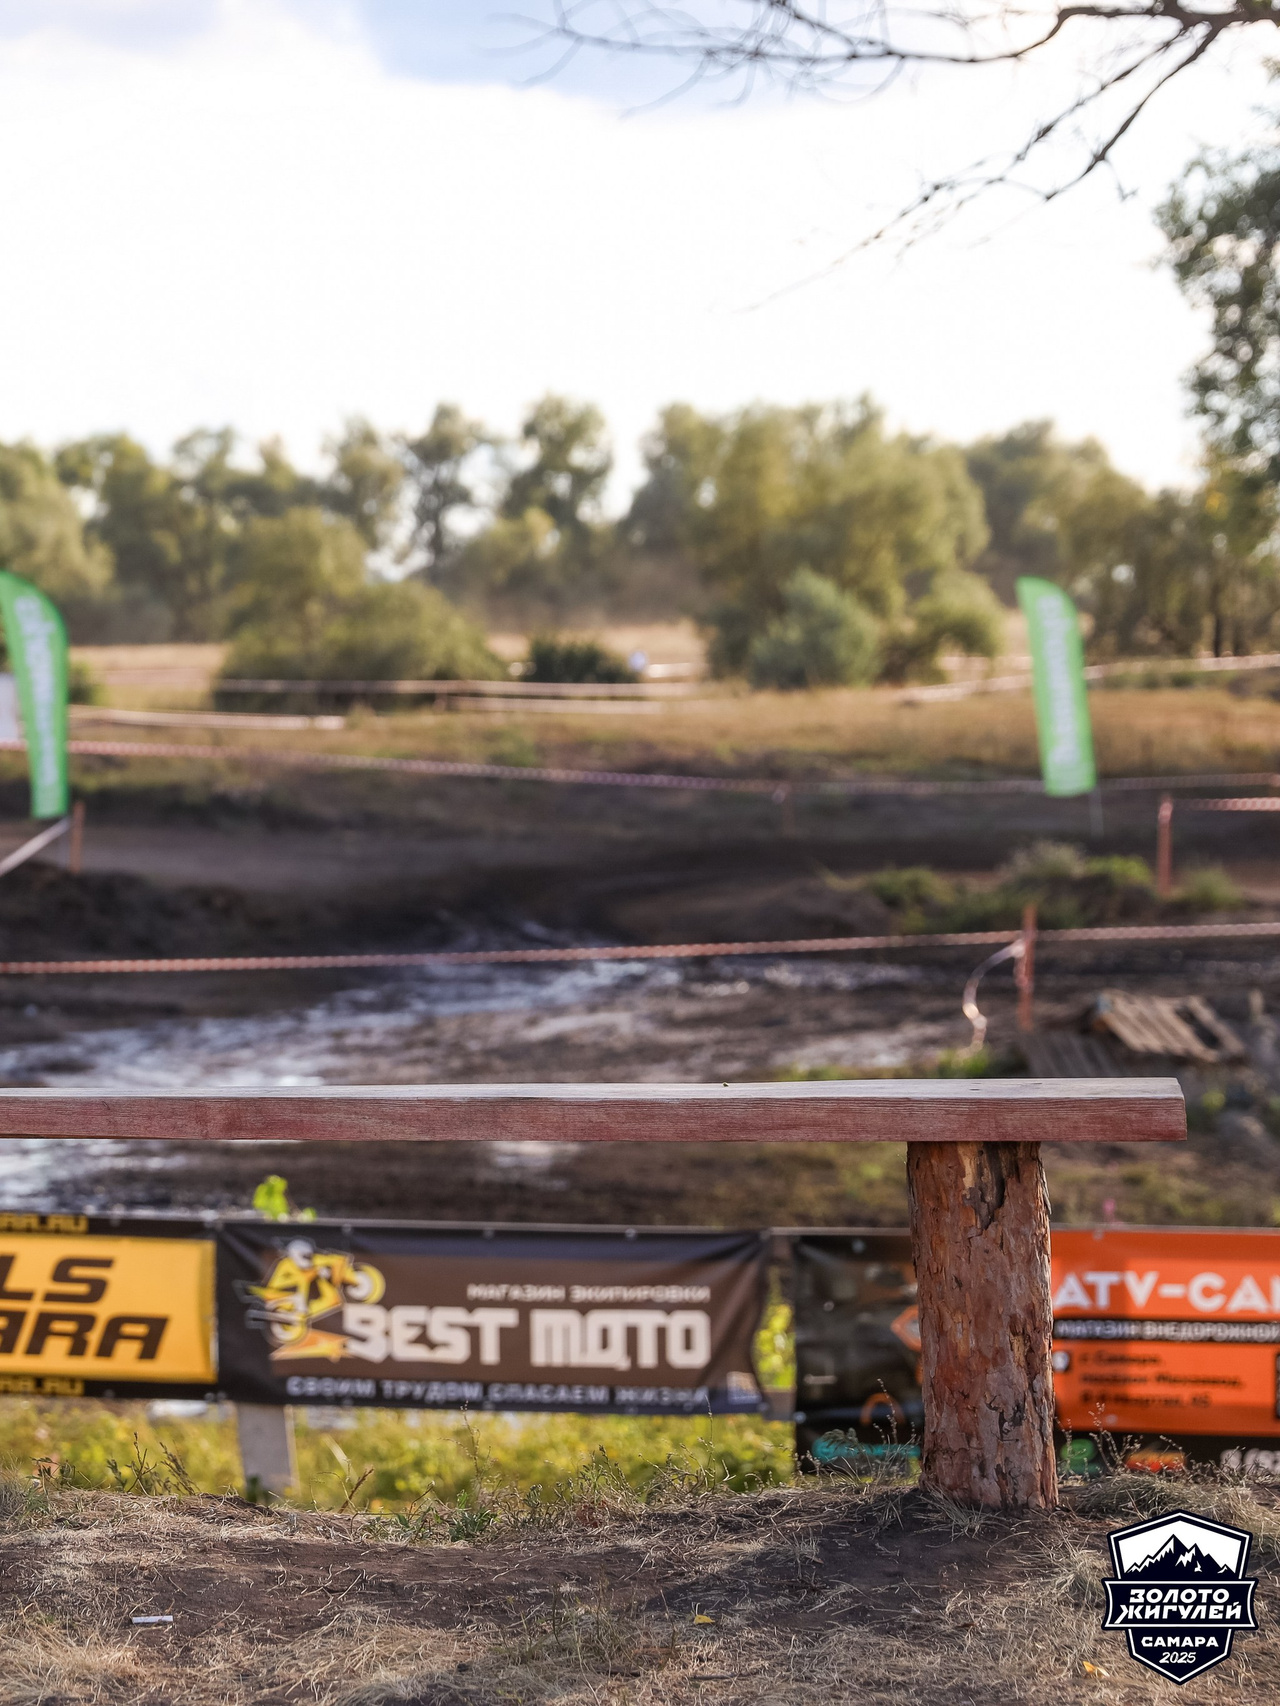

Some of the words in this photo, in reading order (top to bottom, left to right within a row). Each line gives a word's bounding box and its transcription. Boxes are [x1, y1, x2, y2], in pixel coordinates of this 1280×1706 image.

[467, 1284, 566, 1301] МАГАЗИН
[570, 1285, 711, 1303] ЭКИПИРОВКИ
[342, 1303, 519, 1363] BEST
[1057, 1320, 1137, 1339] МАГАЗИН
[286, 1375, 377, 1399] СВОИМ
[381, 1378, 483, 1403] ТРУДОМ
[487, 1382, 610, 1405] СПАСАЕМ
